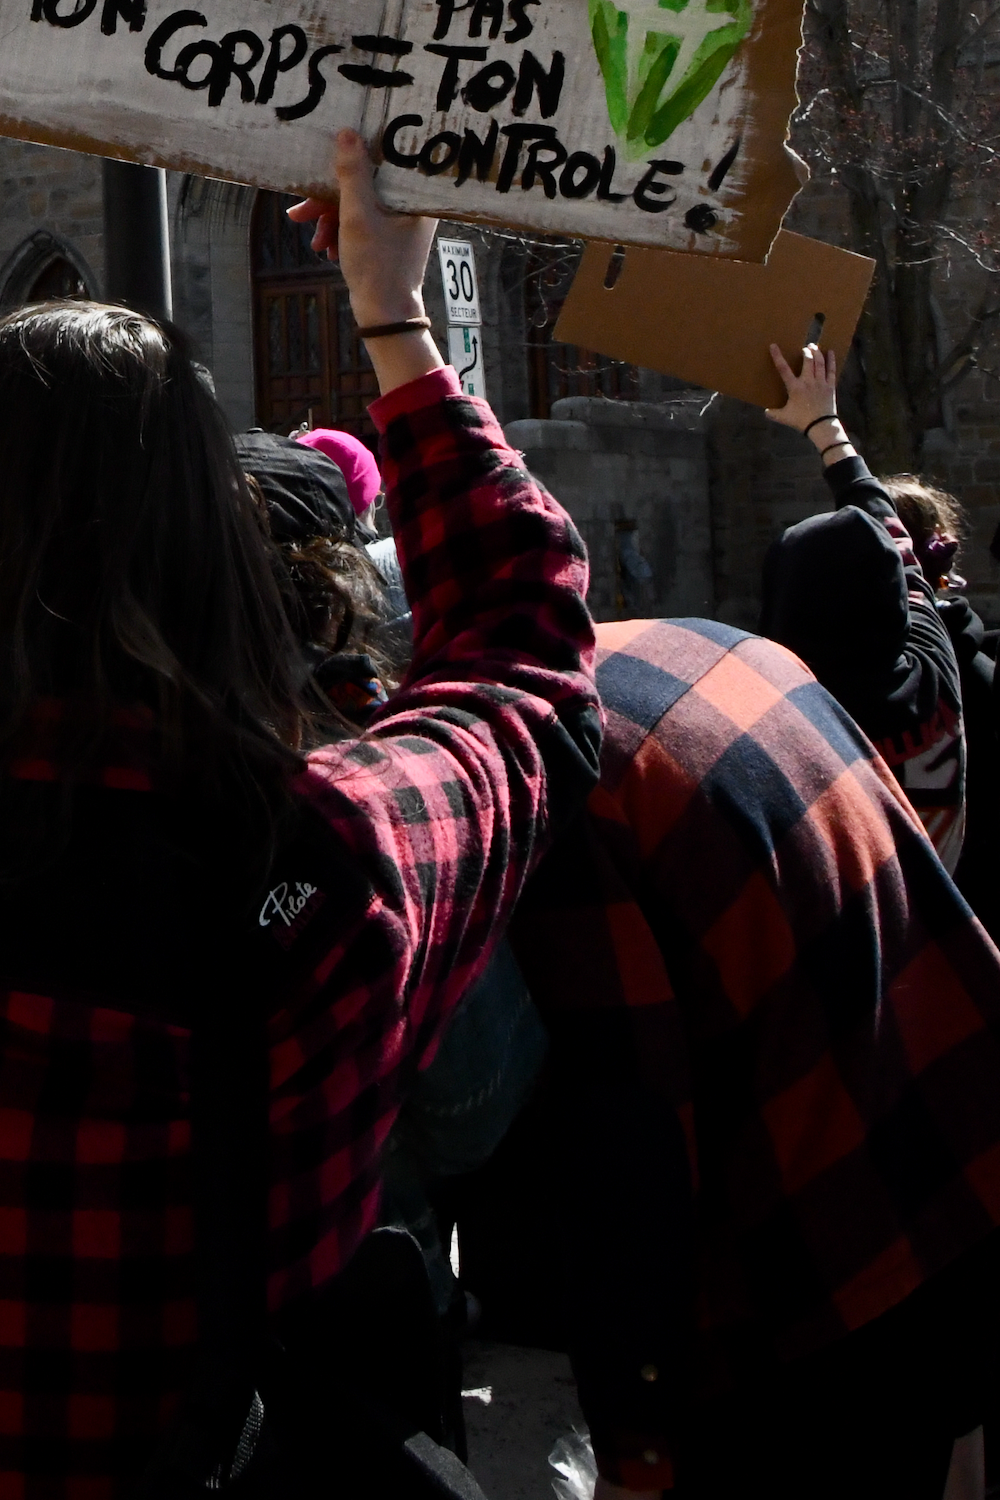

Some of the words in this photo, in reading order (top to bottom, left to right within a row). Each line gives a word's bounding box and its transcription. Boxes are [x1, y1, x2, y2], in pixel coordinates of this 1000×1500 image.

[145, 10, 345, 121] CORPS
[423, 43, 566, 119] TON
[442, 244, 470, 257] MAXIMUM
[446, 259, 474, 302] 30
[450, 306, 477, 319] SECTEUR
